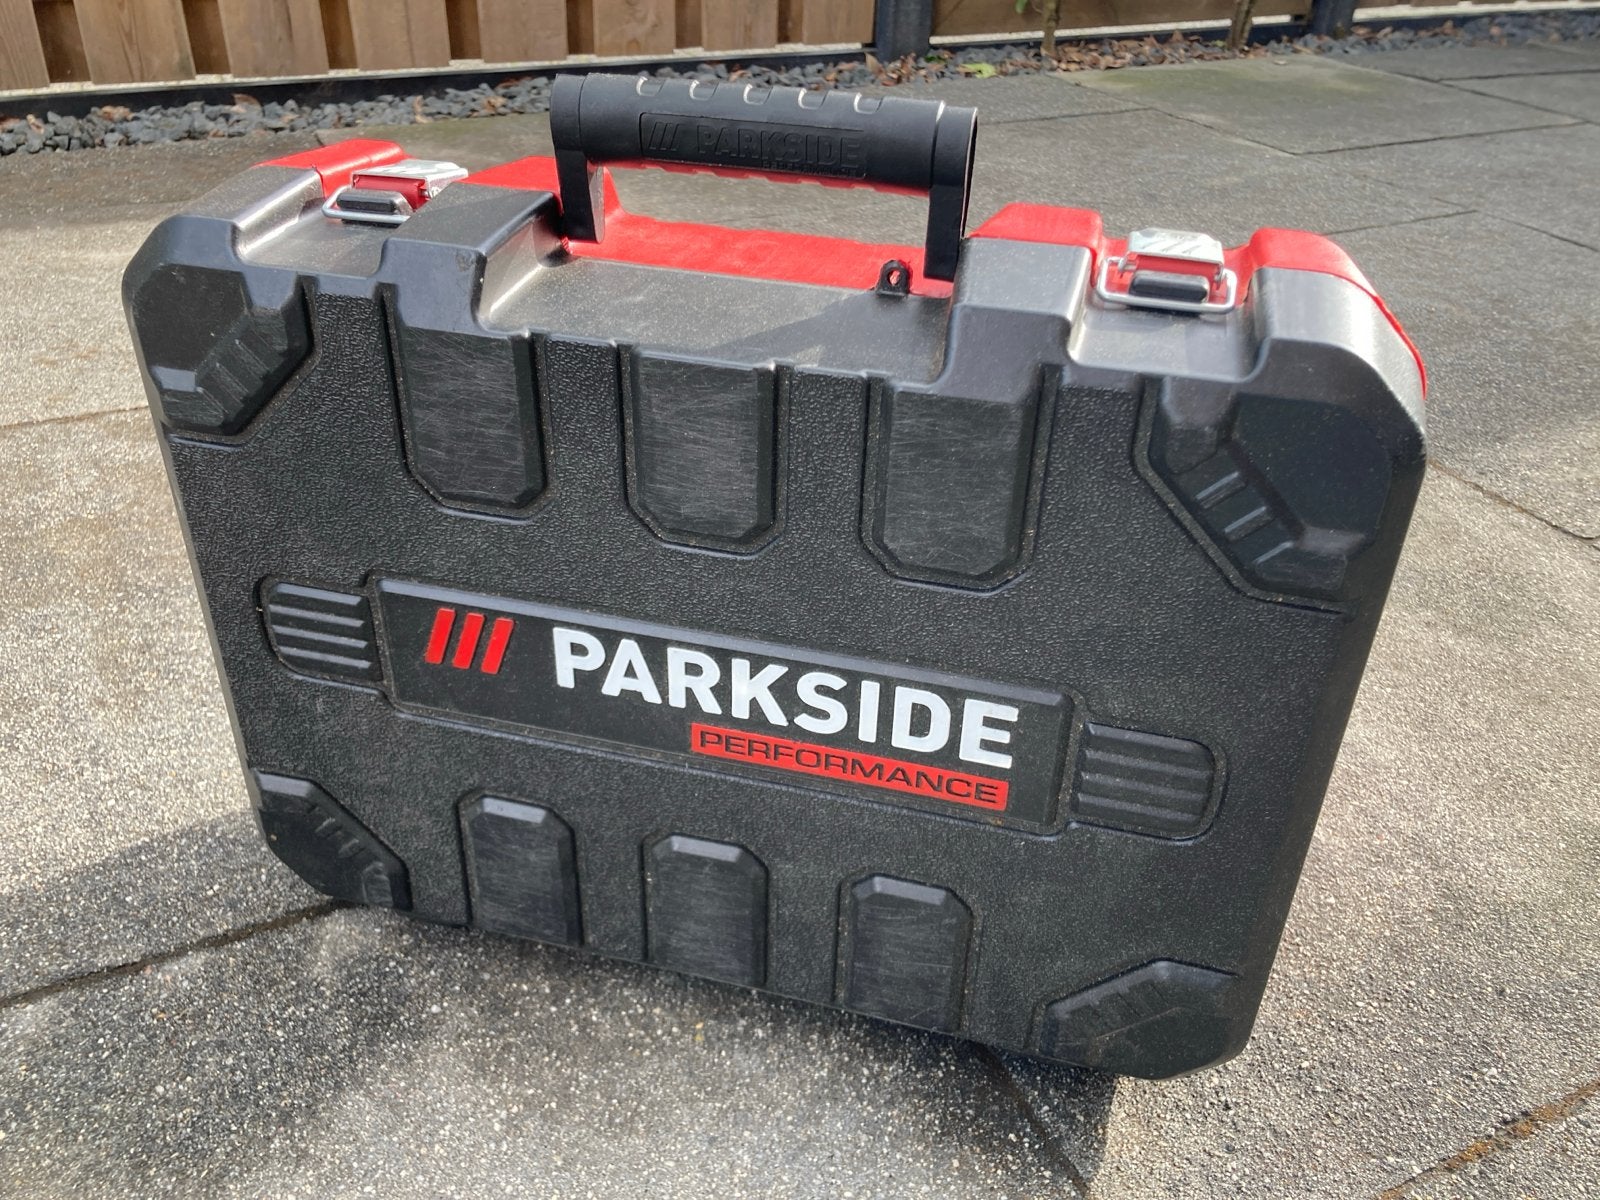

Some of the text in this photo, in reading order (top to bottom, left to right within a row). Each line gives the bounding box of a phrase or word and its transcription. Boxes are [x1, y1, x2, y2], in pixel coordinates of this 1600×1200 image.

[696, 124, 862, 168] PARKSIDE
[553, 627, 1020, 769] PARKSIDE
[699, 730, 1001, 804] PERFORMANCE
